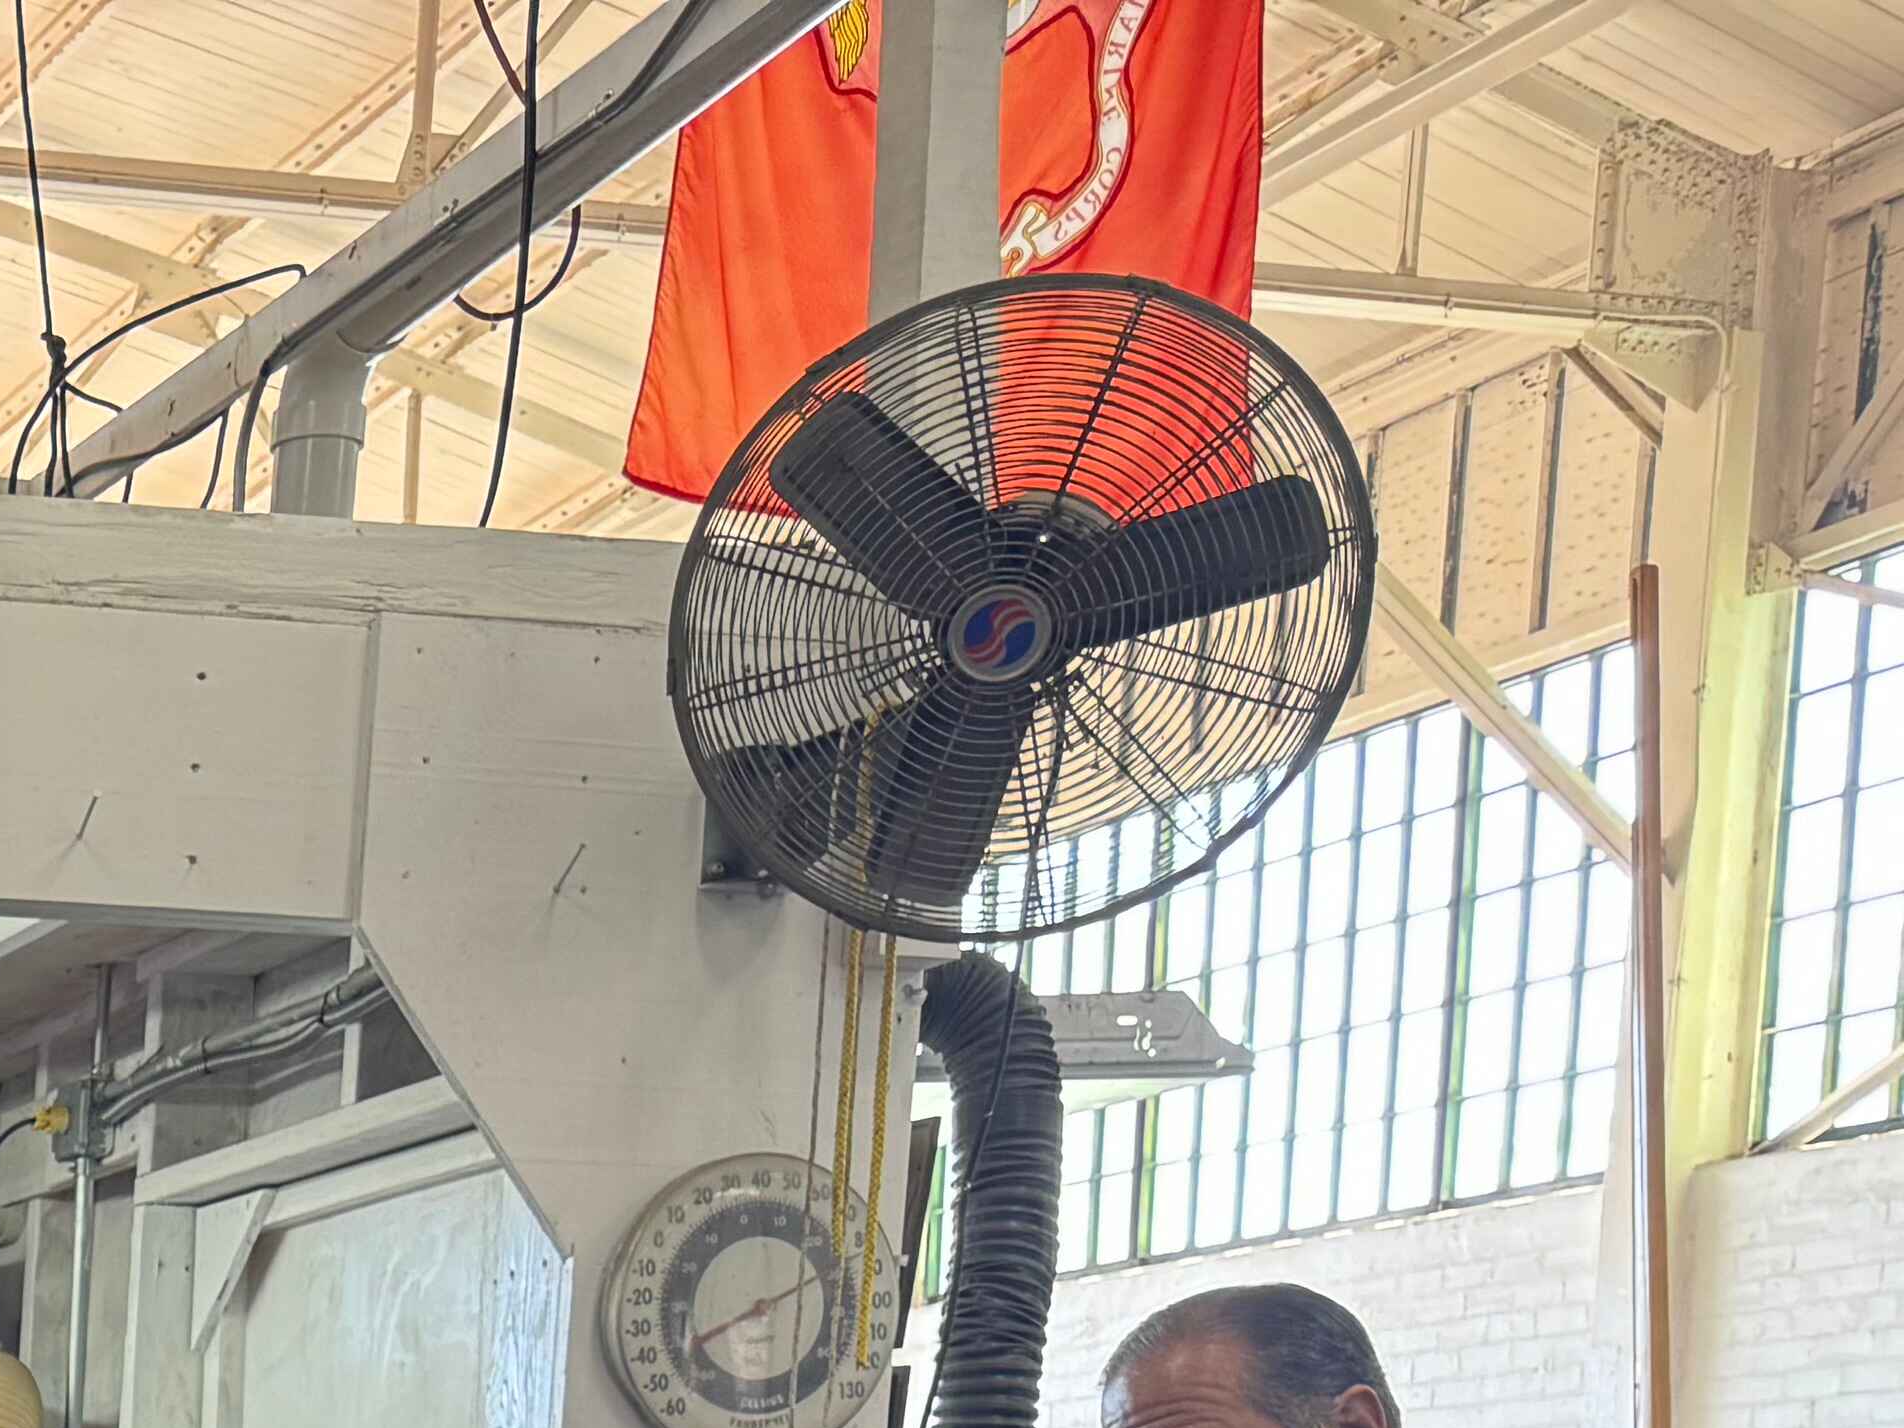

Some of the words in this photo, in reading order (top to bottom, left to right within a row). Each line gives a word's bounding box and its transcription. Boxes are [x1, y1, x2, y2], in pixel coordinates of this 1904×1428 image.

[693, 1186, 713, 1205] 20
[667, 1205, 685, 1224] 10
[653, 1230, 665, 1248] 0
[632, 1258, 656, 1277] -10
[626, 1287, 653, 1306] -20
[625, 1319, 652, 1338] -30
[630, 1346, 658, 1365] -40
[642, 1373, 669, 1392] -50
[838, 1380, 865, 1400] 130
[659, 1397, 686, 1416] -60
